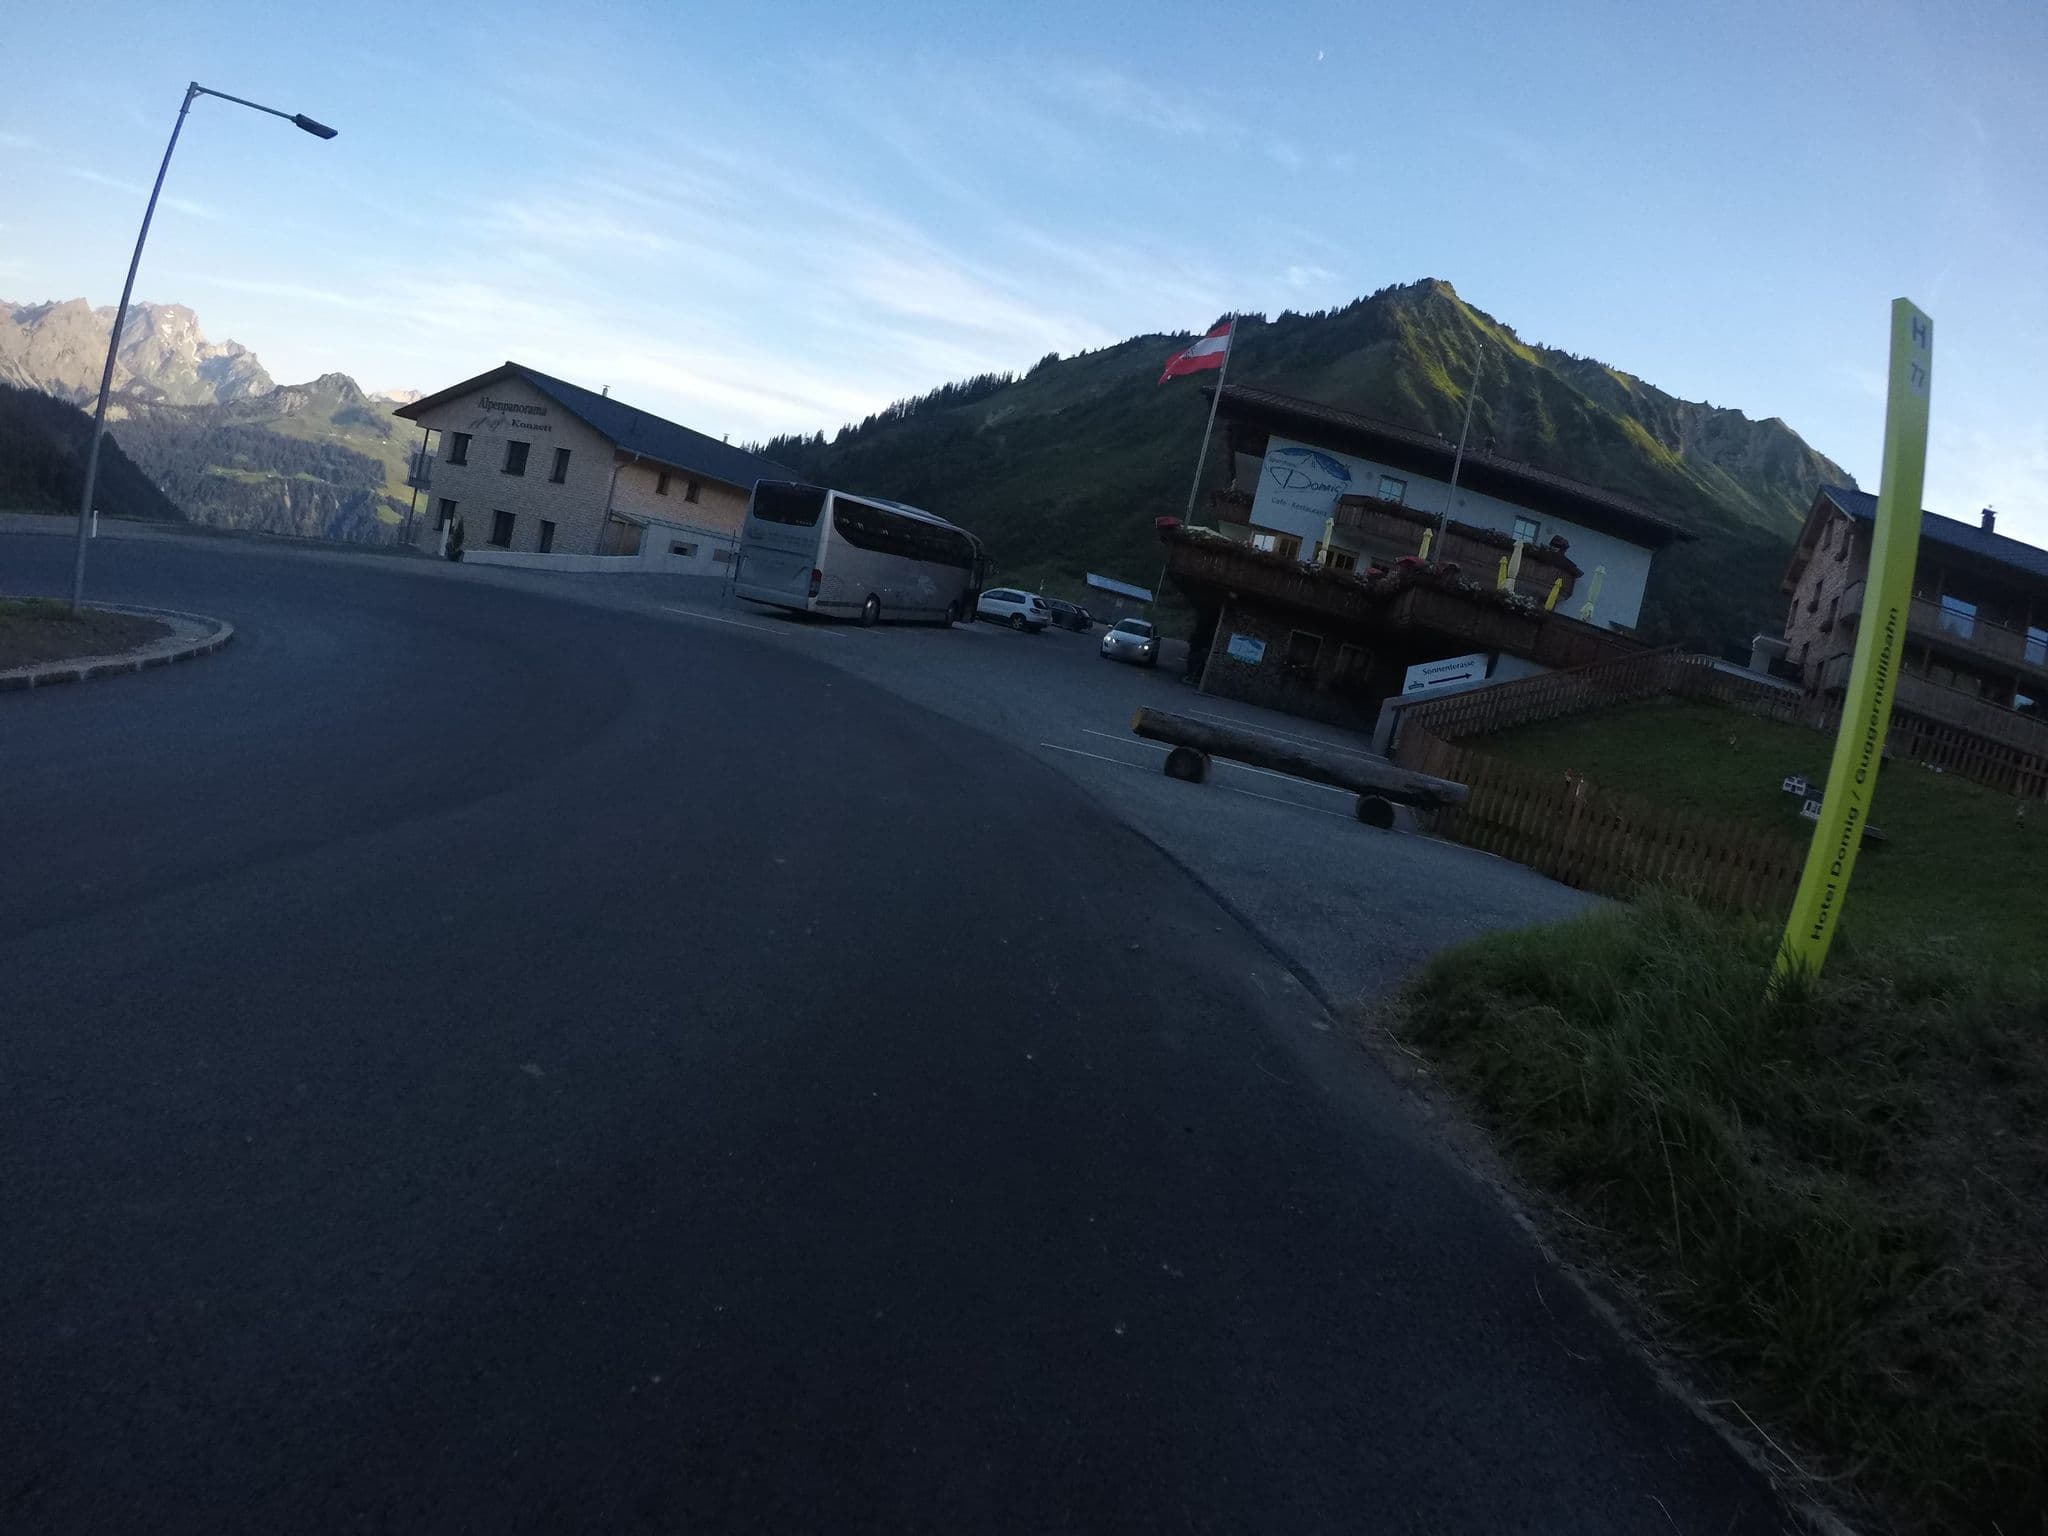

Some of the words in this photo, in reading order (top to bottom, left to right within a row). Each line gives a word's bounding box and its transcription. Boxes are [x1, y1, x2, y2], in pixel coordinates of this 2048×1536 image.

[1911, 316, 1927, 350] H
[1910, 361, 1925, 388] 77
[478, 396, 547, 416] Alpenpanorama
[1422, 660, 1475, 675] Sonnenterasse
[1810, 884, 1836, 941] Hotel
[1830, 806, 1859, 877] Domig
